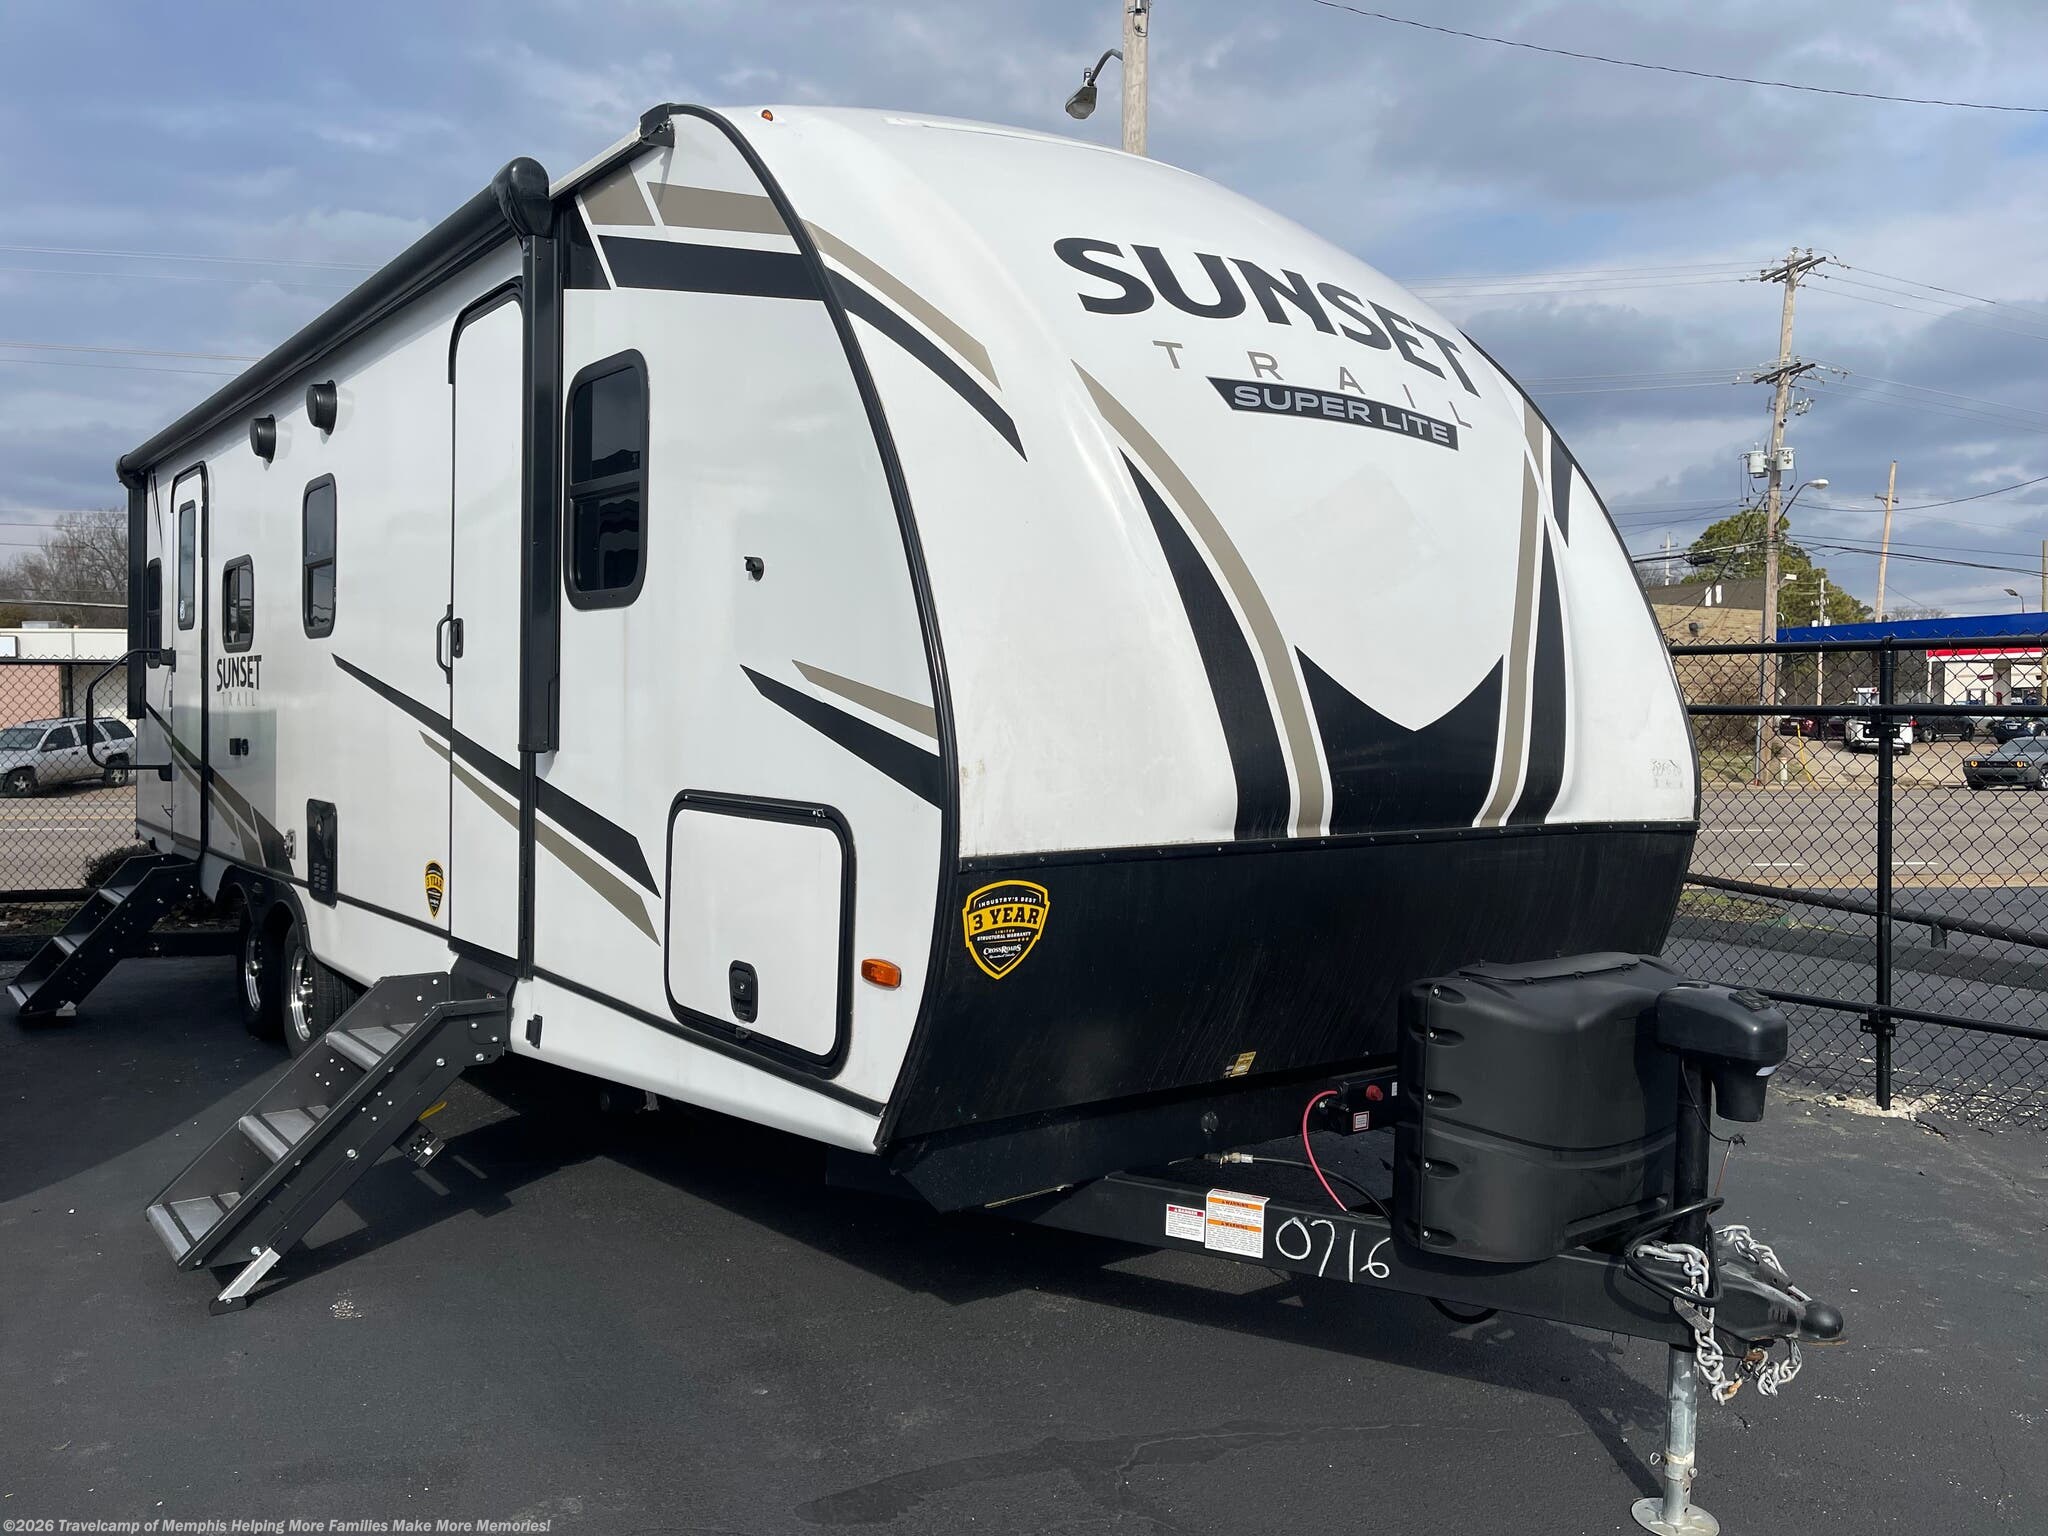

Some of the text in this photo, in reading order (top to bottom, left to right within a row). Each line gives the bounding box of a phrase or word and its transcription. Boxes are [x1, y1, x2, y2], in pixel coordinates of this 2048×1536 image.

[1053, 237, 1481, 399] SUNSET
[1152, 340, 1473, 429] TRAIL
[1234, 385, 1450, 444] SUPER LITE
[216, 655, 262, 692] SUNSET
[221, 691, 256, 707] TRAIL
[973, 907, 1039, 931] 3 YEAR
[978, 897, 1018, 908] INDUSTRY'S
[1276, 1217, 1391, 1283] 0716
